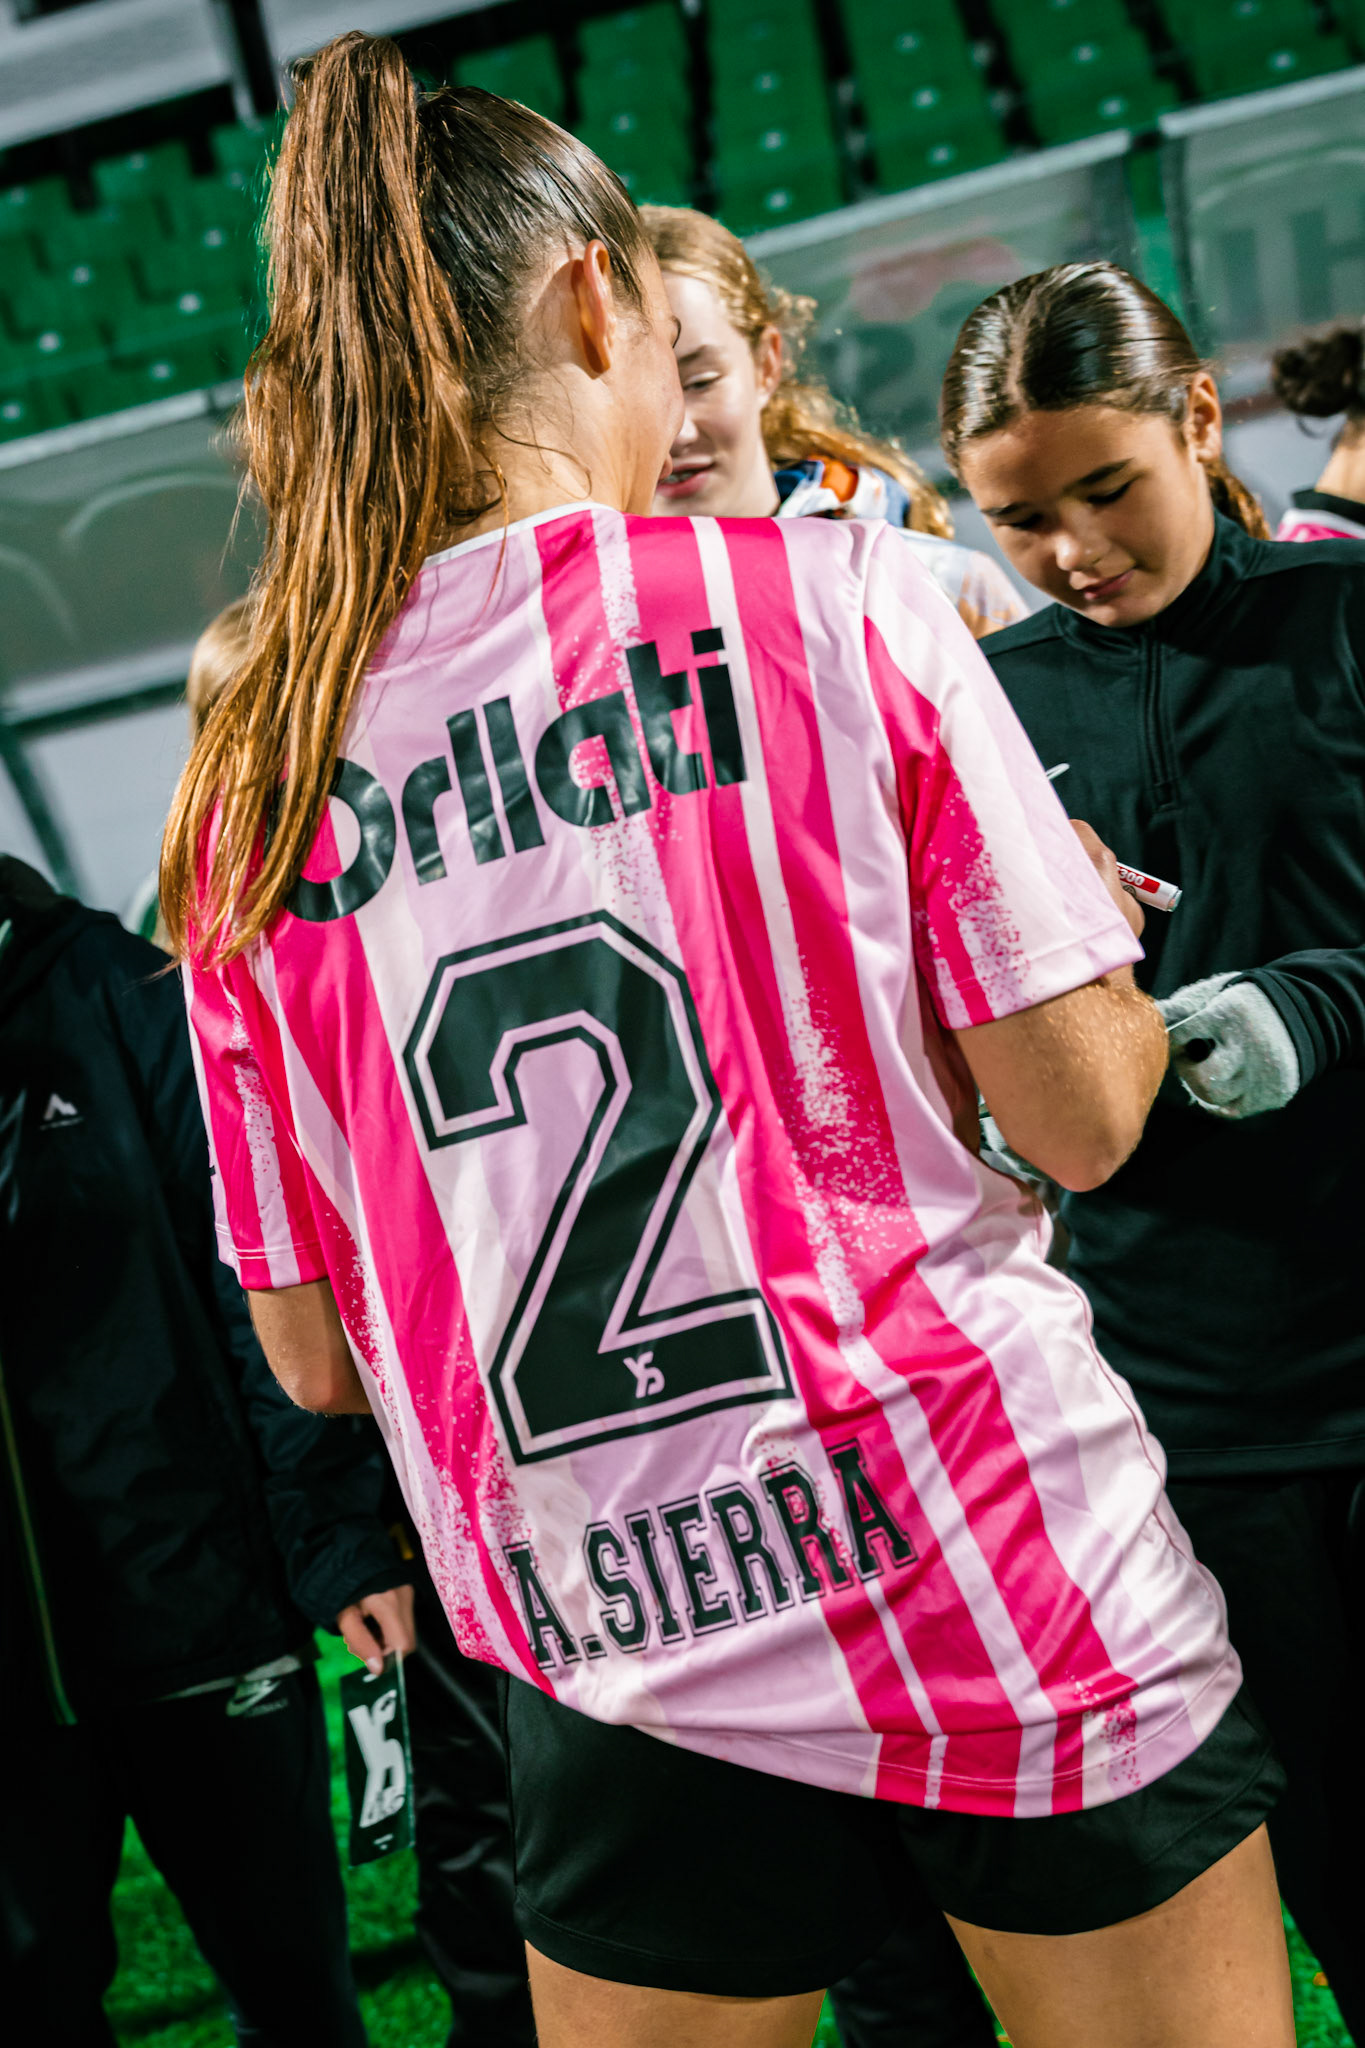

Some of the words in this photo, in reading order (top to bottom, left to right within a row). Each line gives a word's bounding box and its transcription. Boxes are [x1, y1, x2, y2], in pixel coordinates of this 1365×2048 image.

[1117, 867, 1145, 886] 300
[402, 909, 795, 1465] 2
[502, 1437, 919, 1669] A.SIERRA
